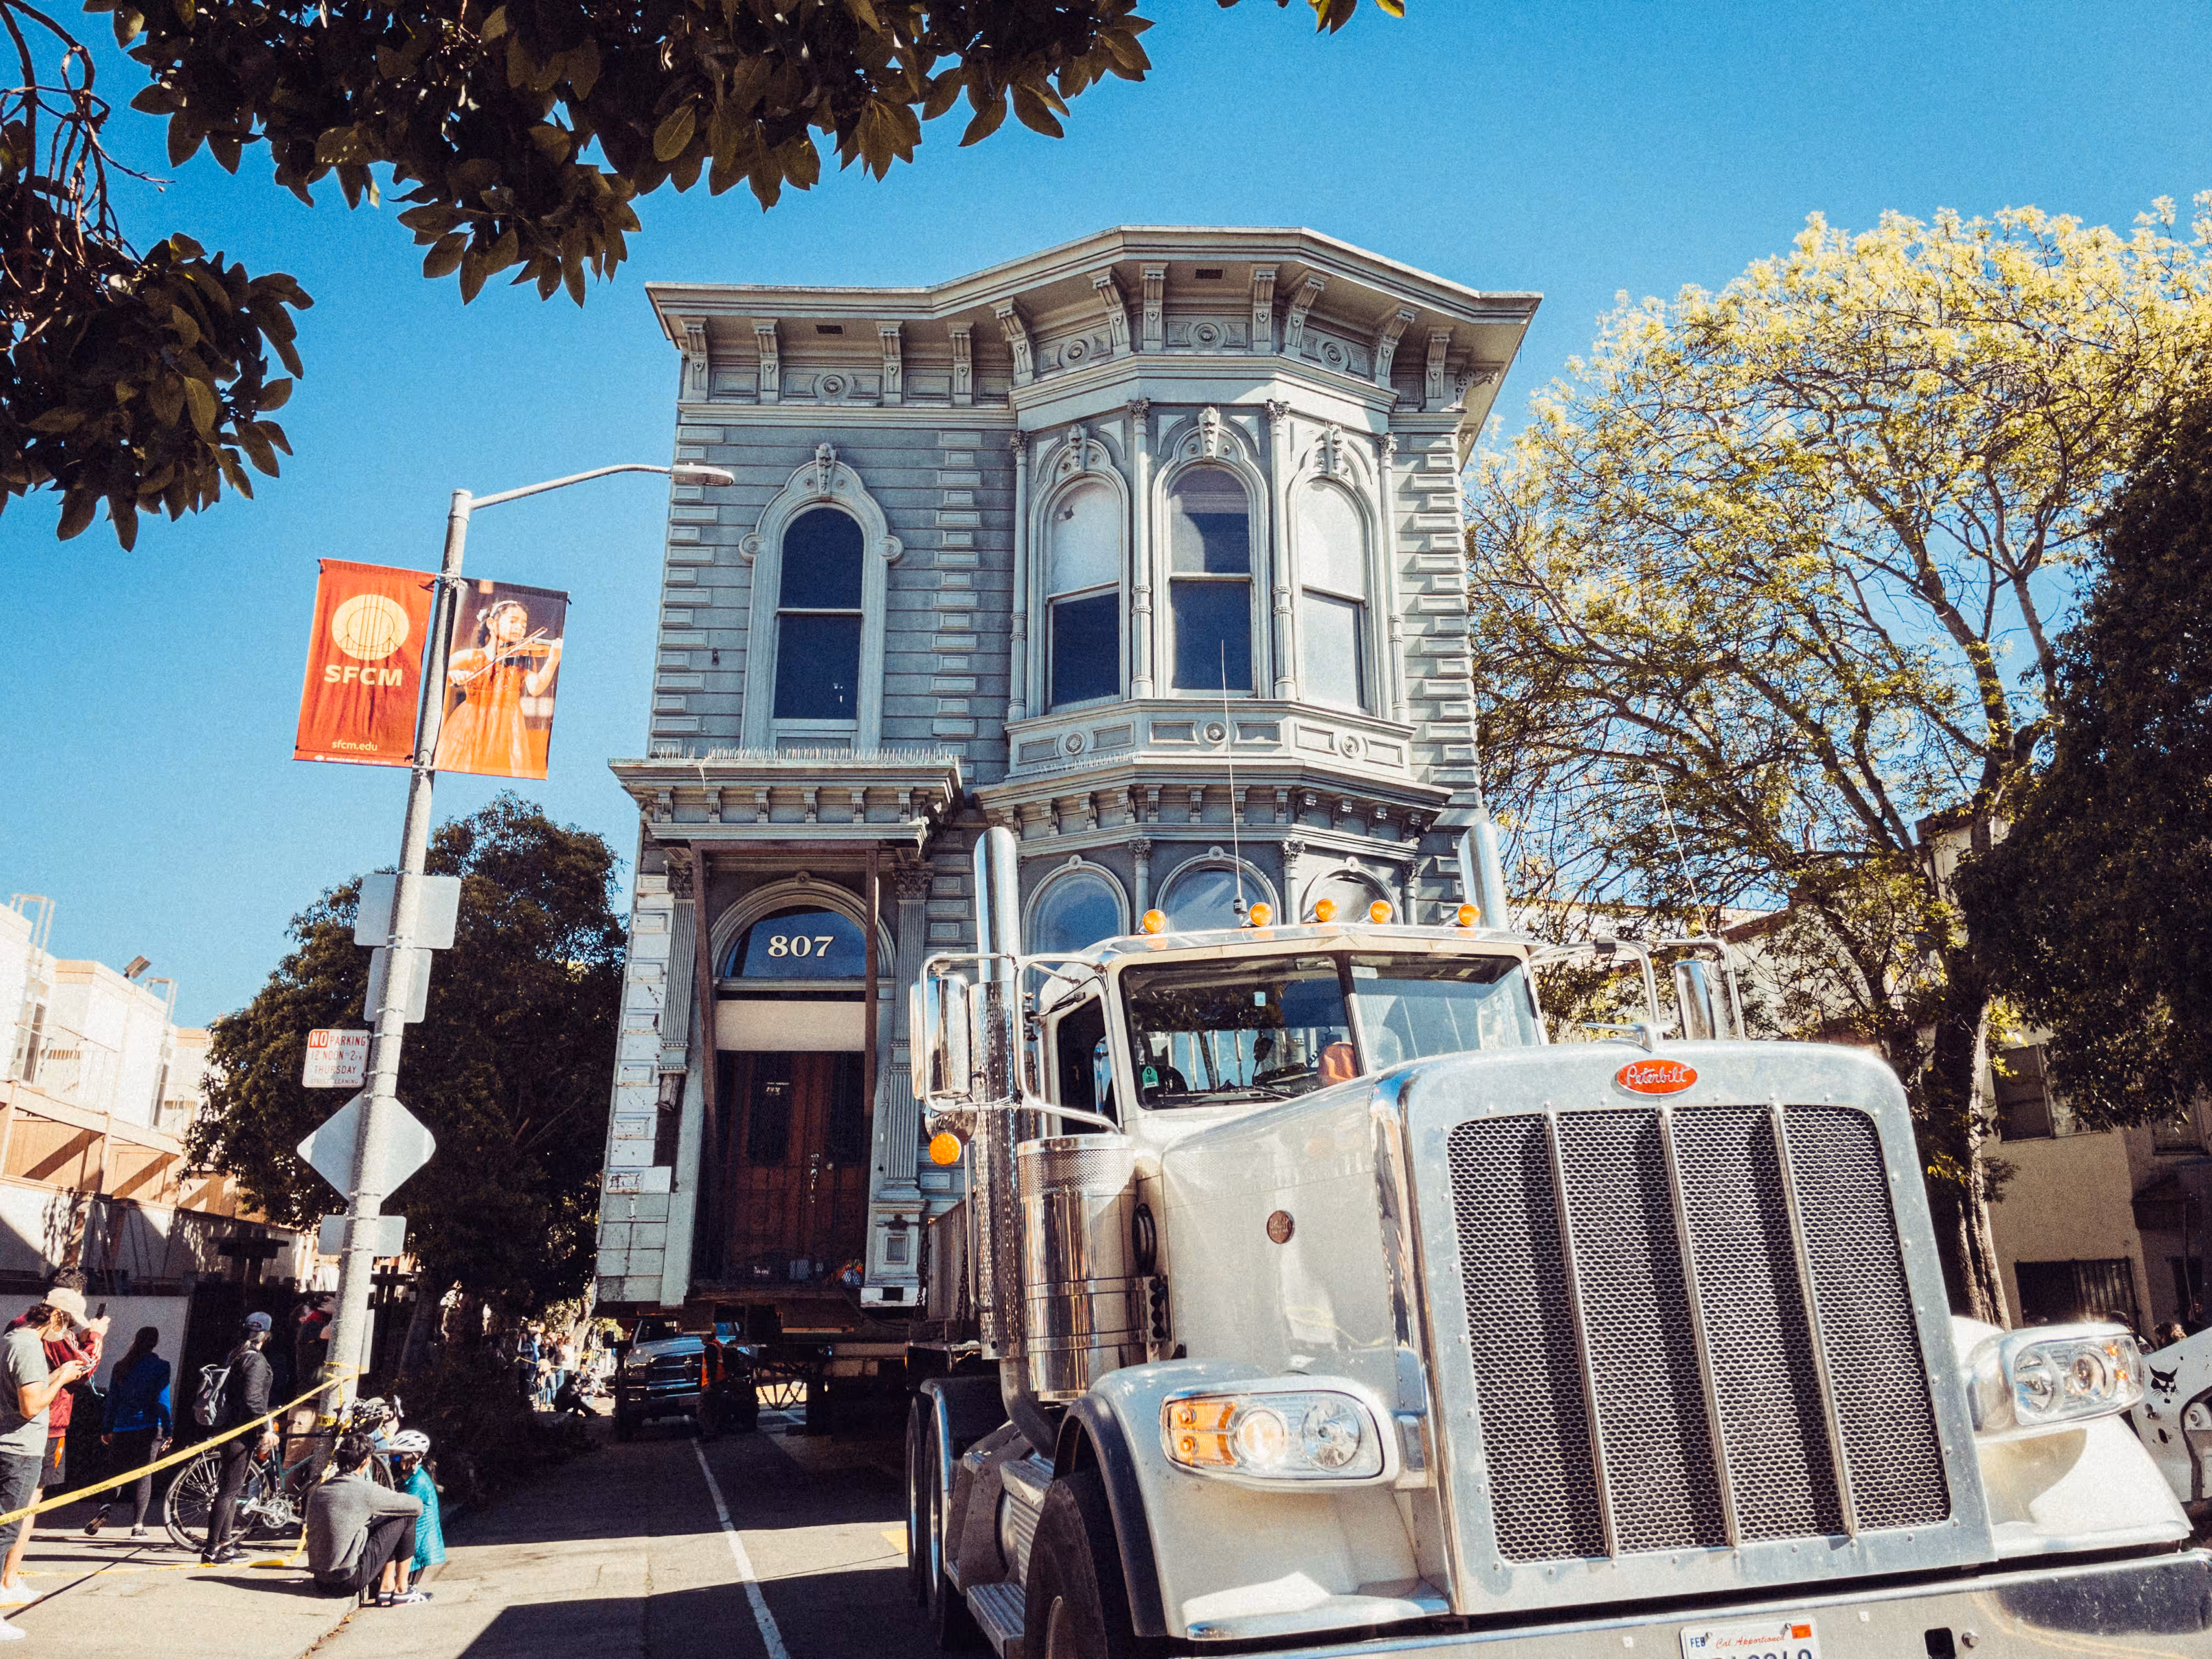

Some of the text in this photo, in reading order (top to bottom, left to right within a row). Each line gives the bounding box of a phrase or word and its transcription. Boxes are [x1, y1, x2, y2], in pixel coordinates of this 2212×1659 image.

[324, 664, 403, 686] SFCM
[332, 740, 377, 751] sfcm.edu
[768, 935, 834, 957] 807
[311, 1031, 366, 1047] NO PARKING
[311, 1050, 319, 1060] 12
[323, 1050, 343, 1060] NOON
[314, 1065, 356, 1075] THURSDAY
[1627, 1065, 1690, 1086] Peterbilt
[881, 1068, 890, 1118] 807
[1690, 1637, 1705, 1648] FEB
[1716, 1634, 1785, 1649] Cal Apportioned
